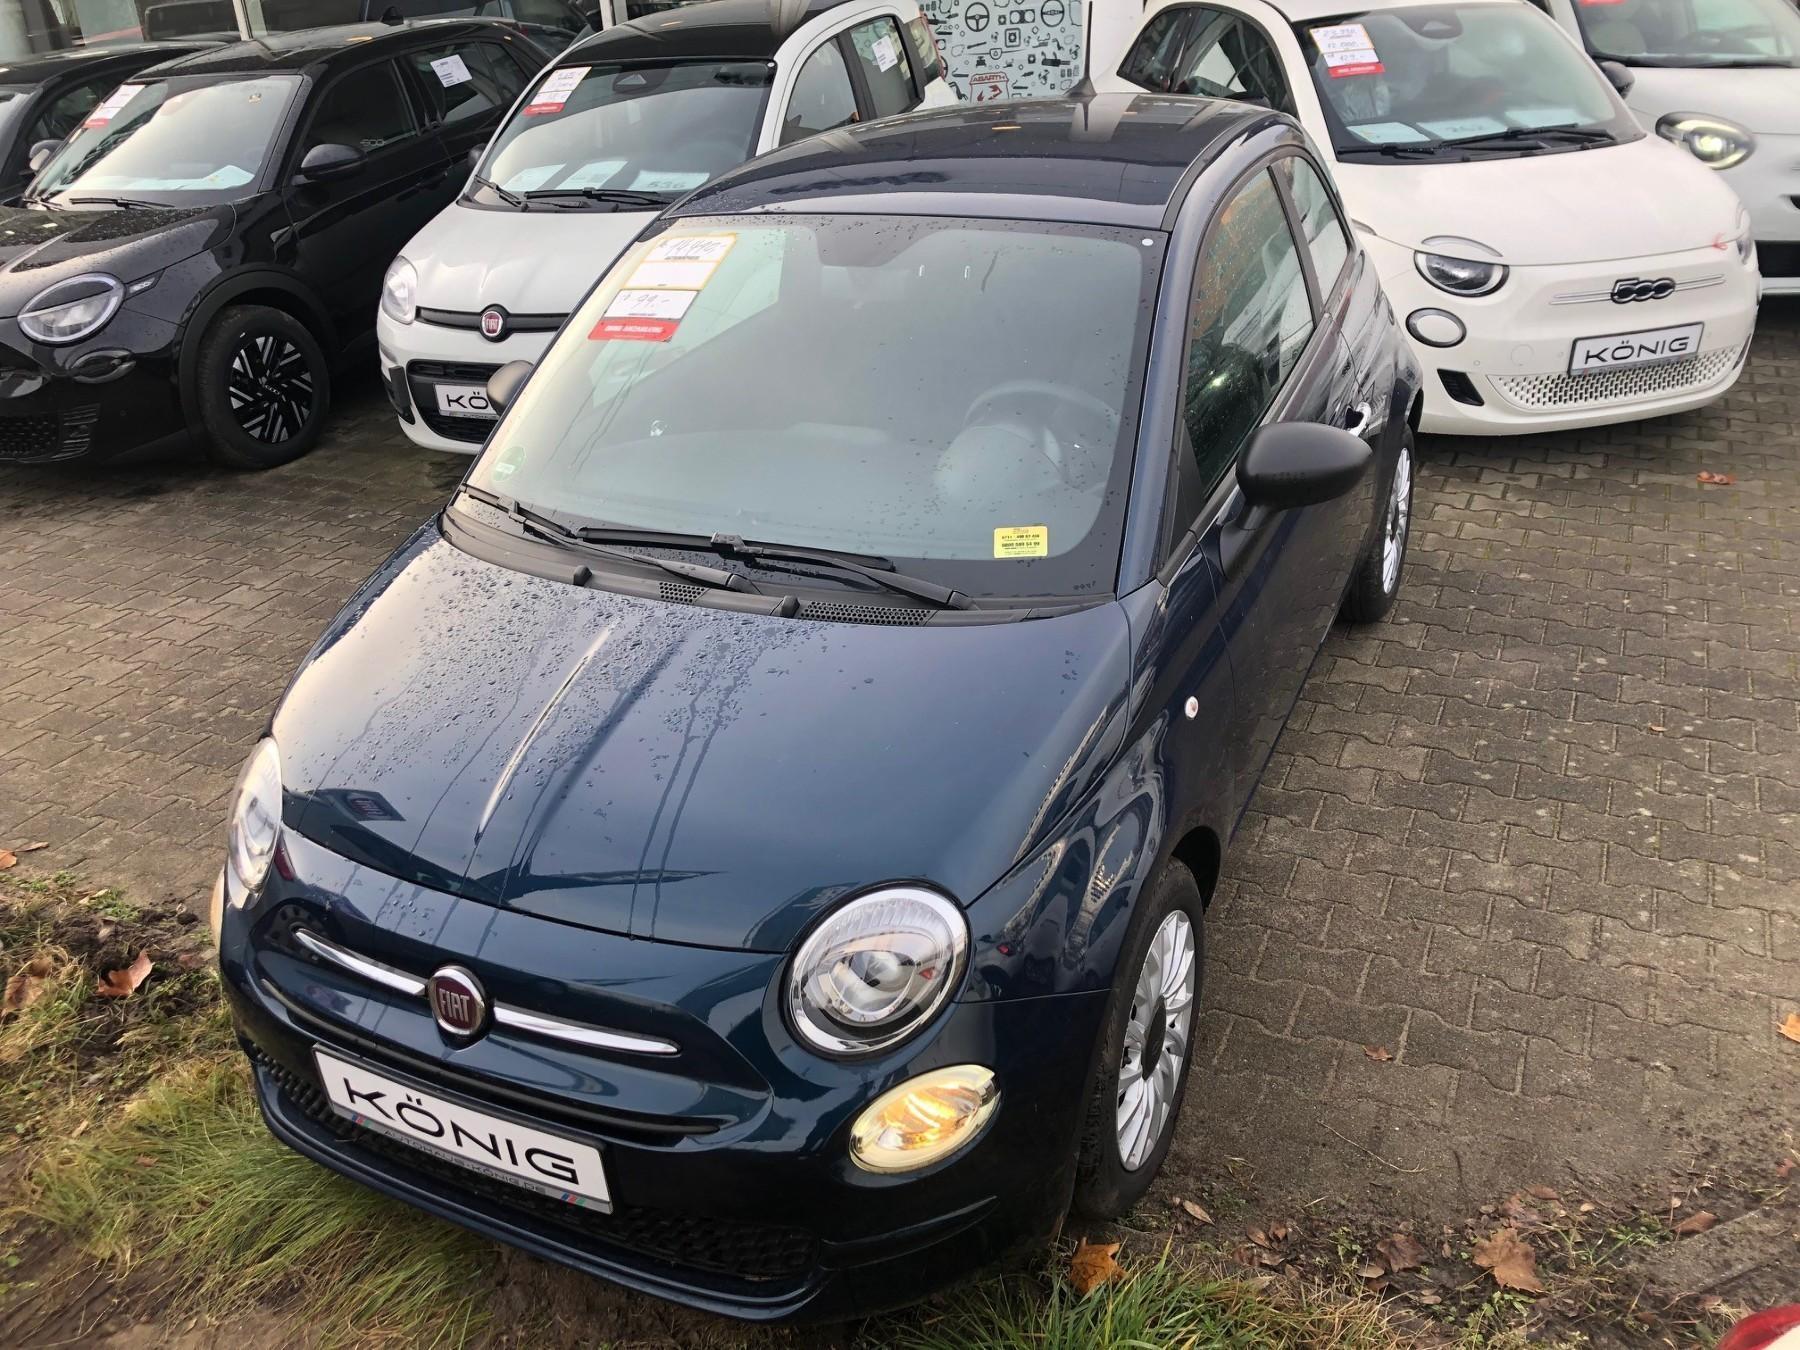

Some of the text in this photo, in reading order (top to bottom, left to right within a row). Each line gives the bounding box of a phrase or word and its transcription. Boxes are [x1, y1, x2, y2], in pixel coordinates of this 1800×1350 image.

[973, 73, 1006, 82] ABARTH
[1611, 277, 1676, 304] 500
[484, 318, 500, 331] FIAT
[1584, 336, 1690, 365] KÖNIG
[439, 988, 470, 1022] FIAT
[342, 1077, 581, 1185] KÖNIG
